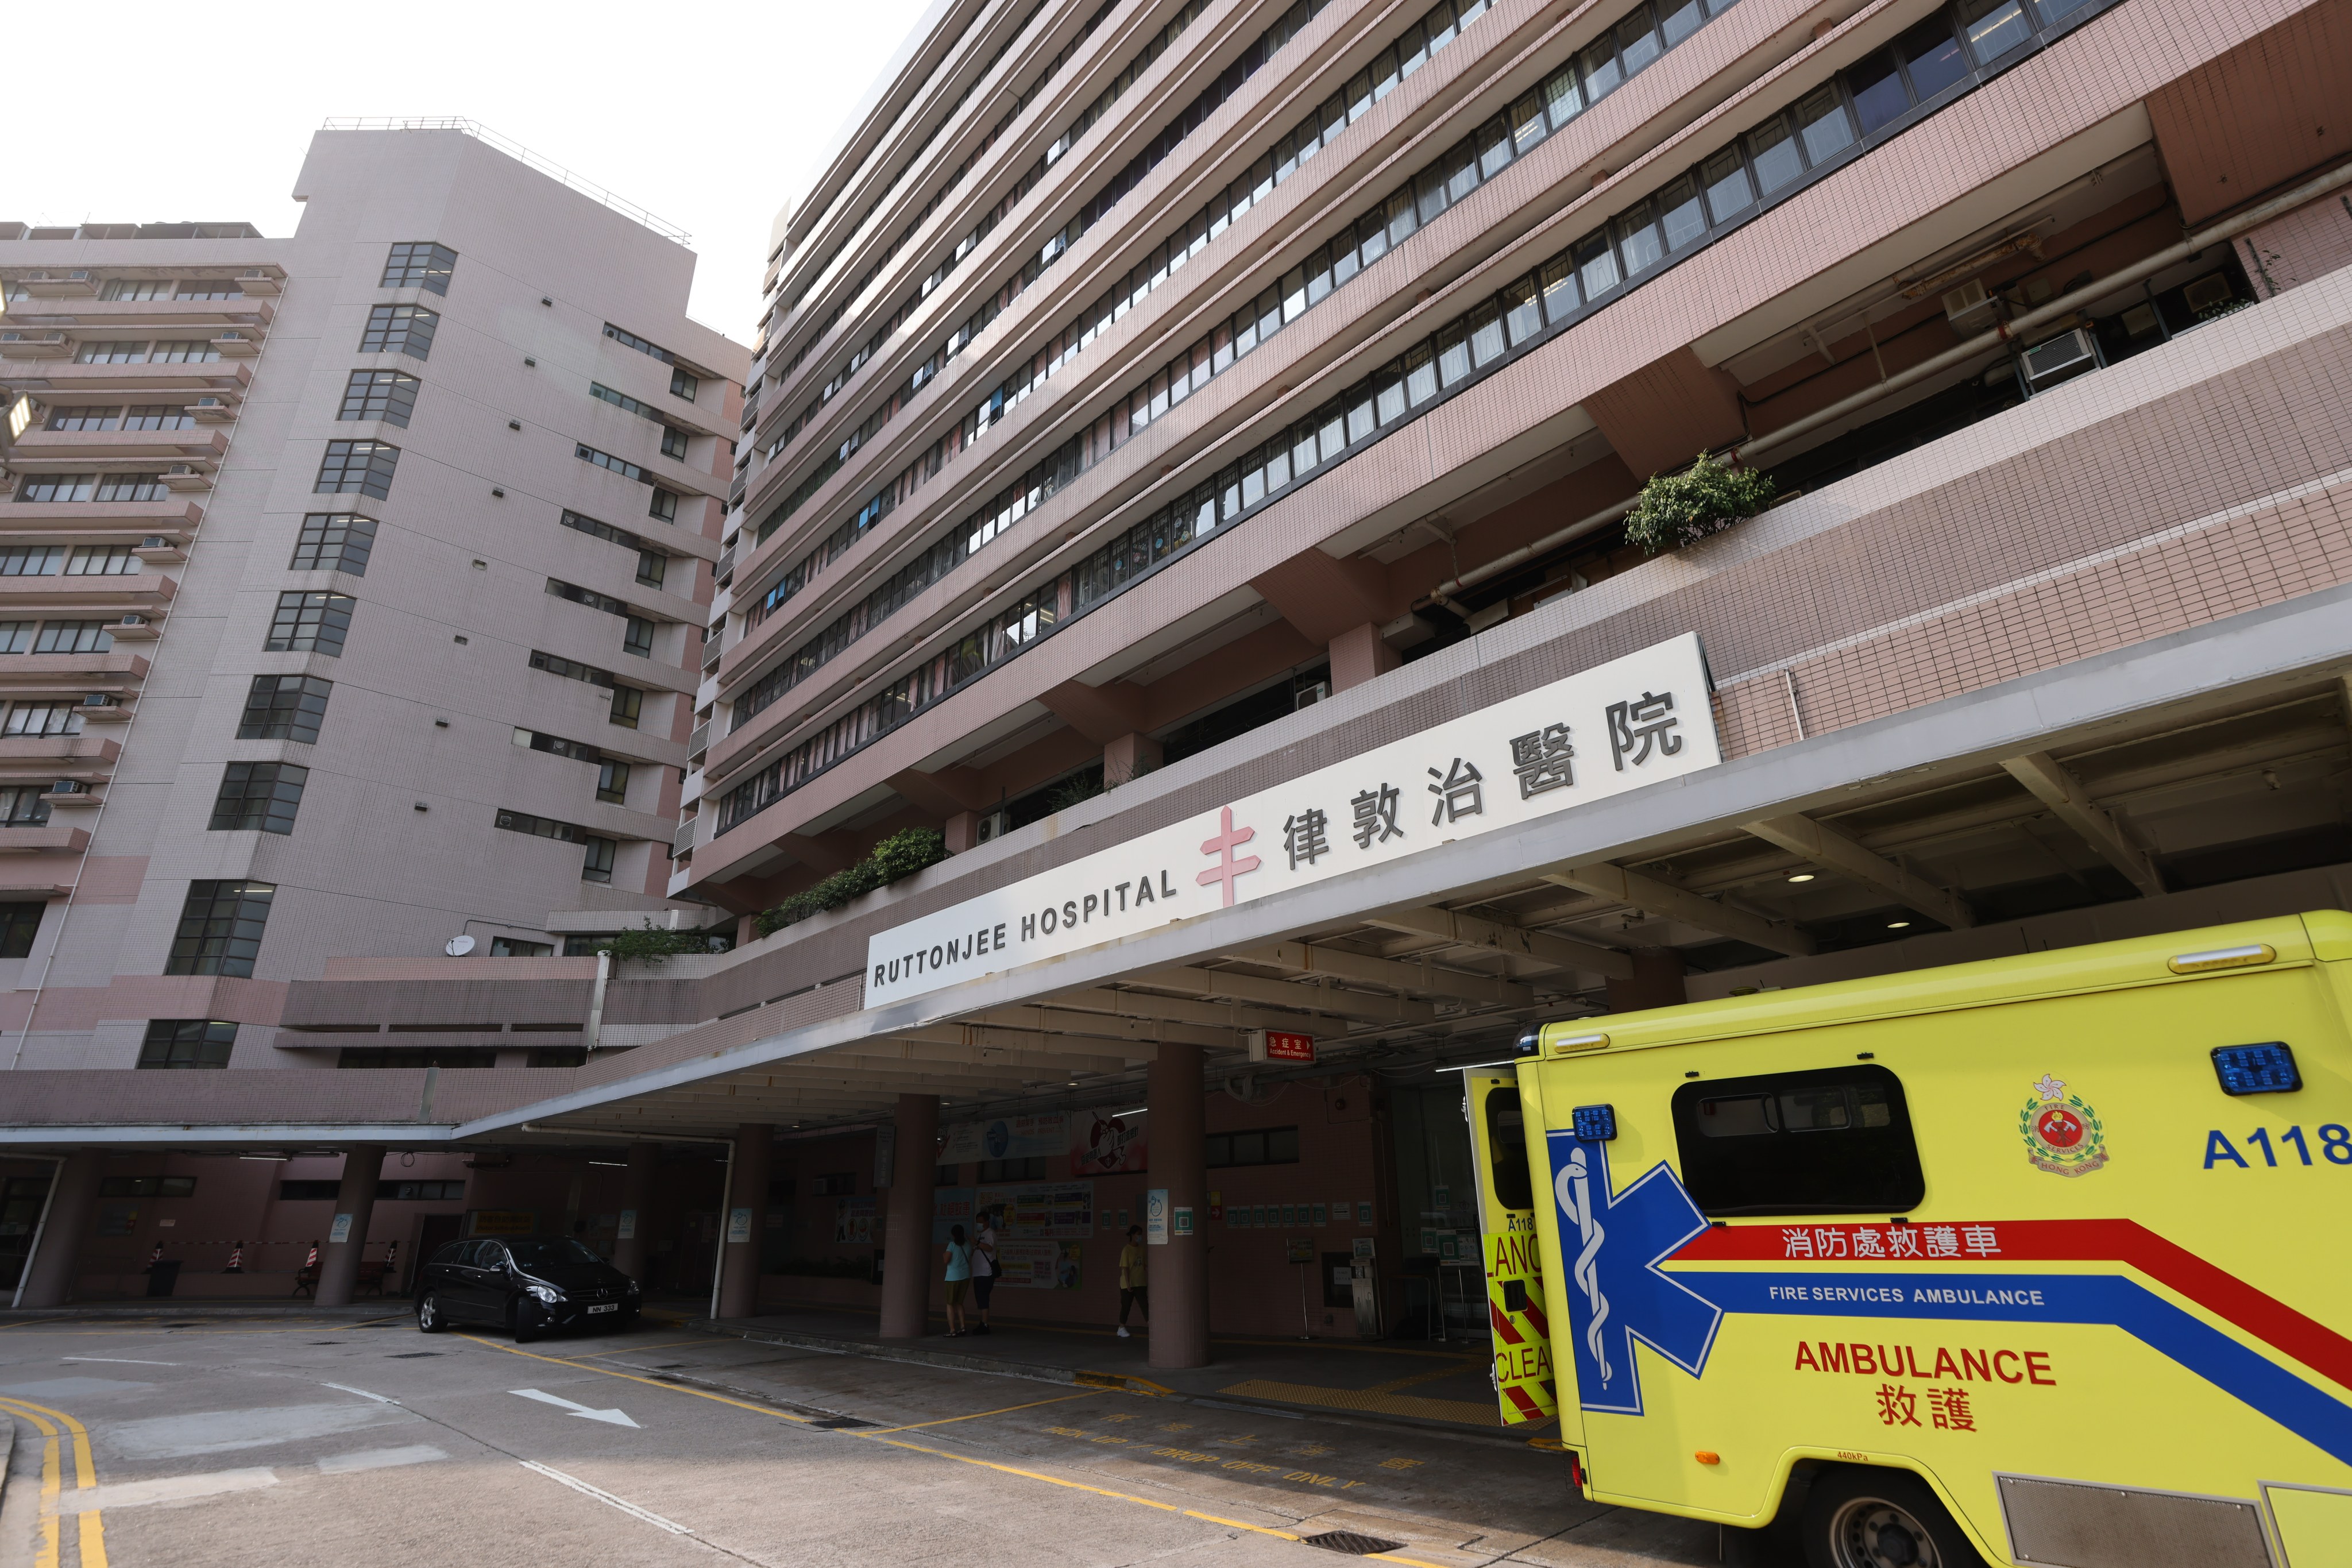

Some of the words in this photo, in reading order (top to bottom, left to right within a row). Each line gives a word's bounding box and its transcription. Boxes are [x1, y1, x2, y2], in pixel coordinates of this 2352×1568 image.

[1283, 691, 1682, 871] 律敦治醫院
[874, 923, 1006, 987] RUTTONJEE
[1021, 870, 1176, 941] HOSPITAL
[1269, 1036, 1301, 1049] 急症室
[1291, 1050, 1311, 1058] Emergency
[2046, 1143, 2084, 1154] SERVICES
[2203, 1123, 2352, 1169] A118
[2041, 1162, 2069, 1175] HONG
[2073, 1161, 2099, 1175] KONG
[1508, 1218, 1534, 1231] A118
[1782, 1224, 2002, 1258] 消防處救護車
[1769, 1286, 1809, 1300] FIRE
[1812, 1287, 1905, 1303] SERVICES
[1913, 1288, 2045, 1306] AMBULANCE
[1496, 1346, 1554, 1383] CLEA
[1795, 1341, 2057, 1387] AMBULANCE
[1876, 1383, 1978, 1432] 救護
[1041, 1427, 1093, 1438] PICK
[1091, 1435, 1129, 1444] UP
[1150, 1447, 1221, 1462] DROP
[1221, 1461, 1281, 1473] OFF
[1283, 1472, 1366, 1489] ONLY
[1837, 1451, 1868, 1462] 440kPa
